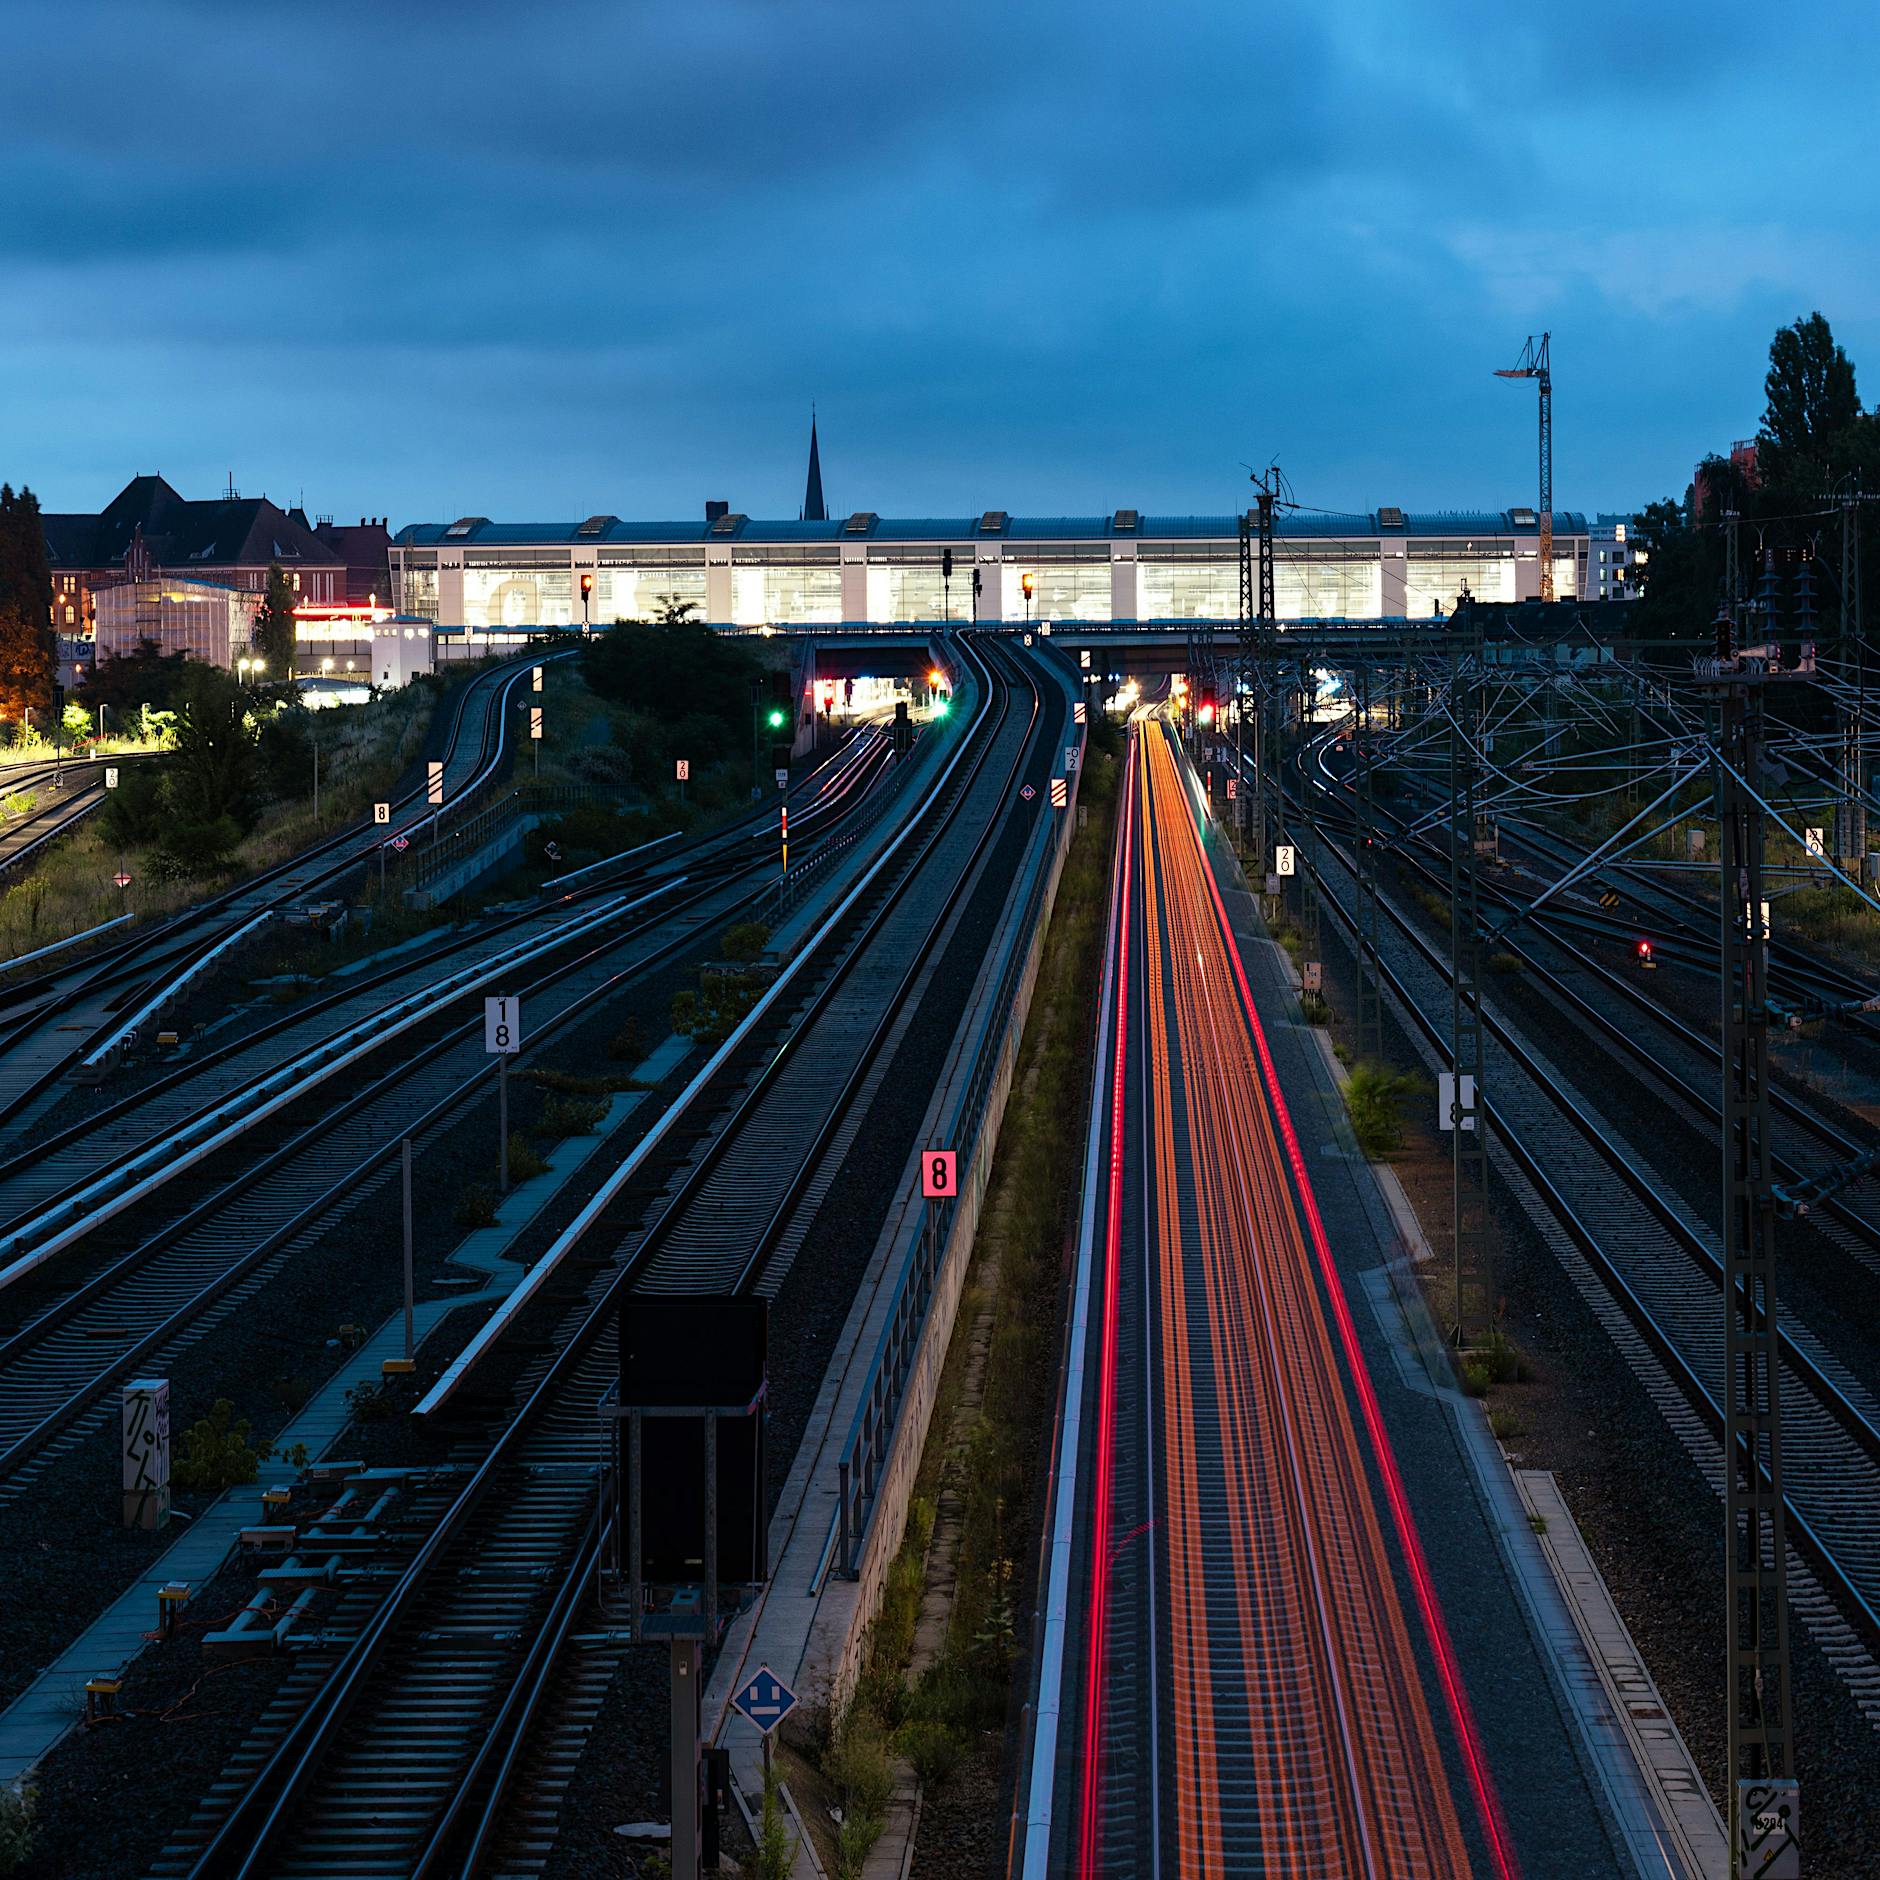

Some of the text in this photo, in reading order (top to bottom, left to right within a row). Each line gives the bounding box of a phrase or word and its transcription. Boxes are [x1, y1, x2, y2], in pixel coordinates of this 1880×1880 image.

[1066, 748, 1079, 758] -0
[1069, 758, 1076, 769] 2
[110, 769, 115, 778] 2
[109, 778, 116, 786] 0
[378, 806, 386, 820] 8
[1282, 848, 1290, 860] 2
[1281, 860, 1290, 872] 0
[498, 1000, 506, 1022] 1
[495, 1024, 510, 1047] 8
[932, 1157, 947, 1190] 8
